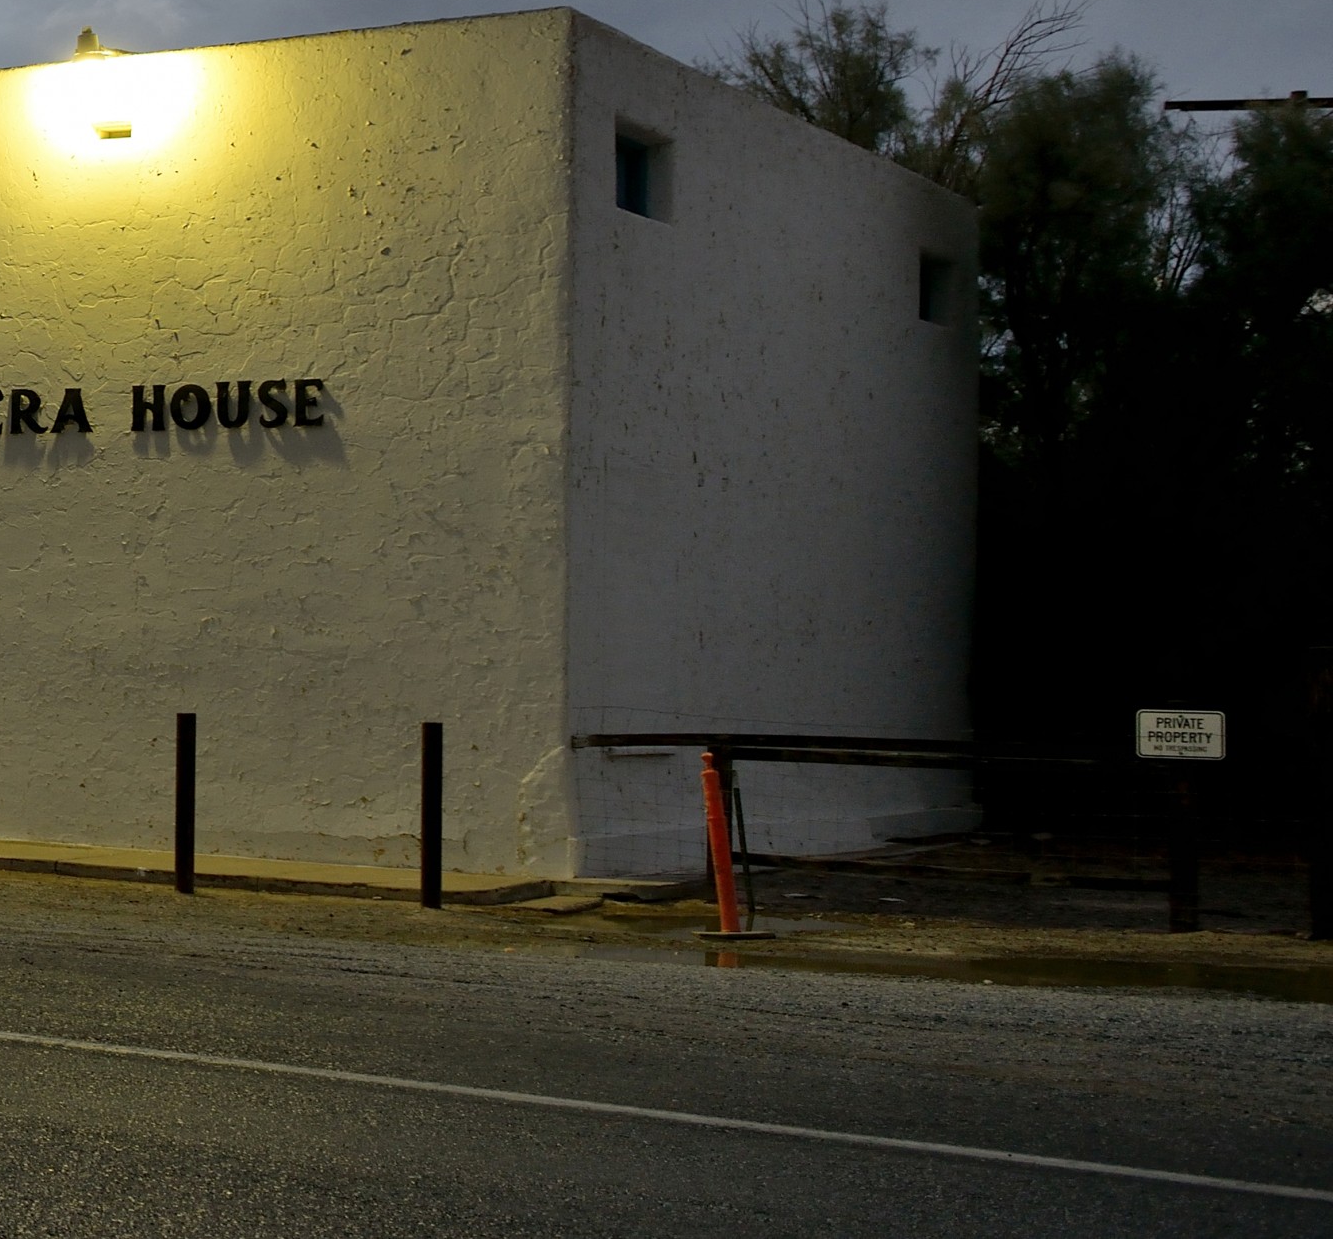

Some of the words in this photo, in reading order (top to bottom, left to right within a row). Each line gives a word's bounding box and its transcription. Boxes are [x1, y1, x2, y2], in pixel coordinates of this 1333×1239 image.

[131, 378, 325, 432] HOUSE
[1156, 717, 1205, 730] PRIVATE
[1148, 731, 1213, 744] PROPERTY
